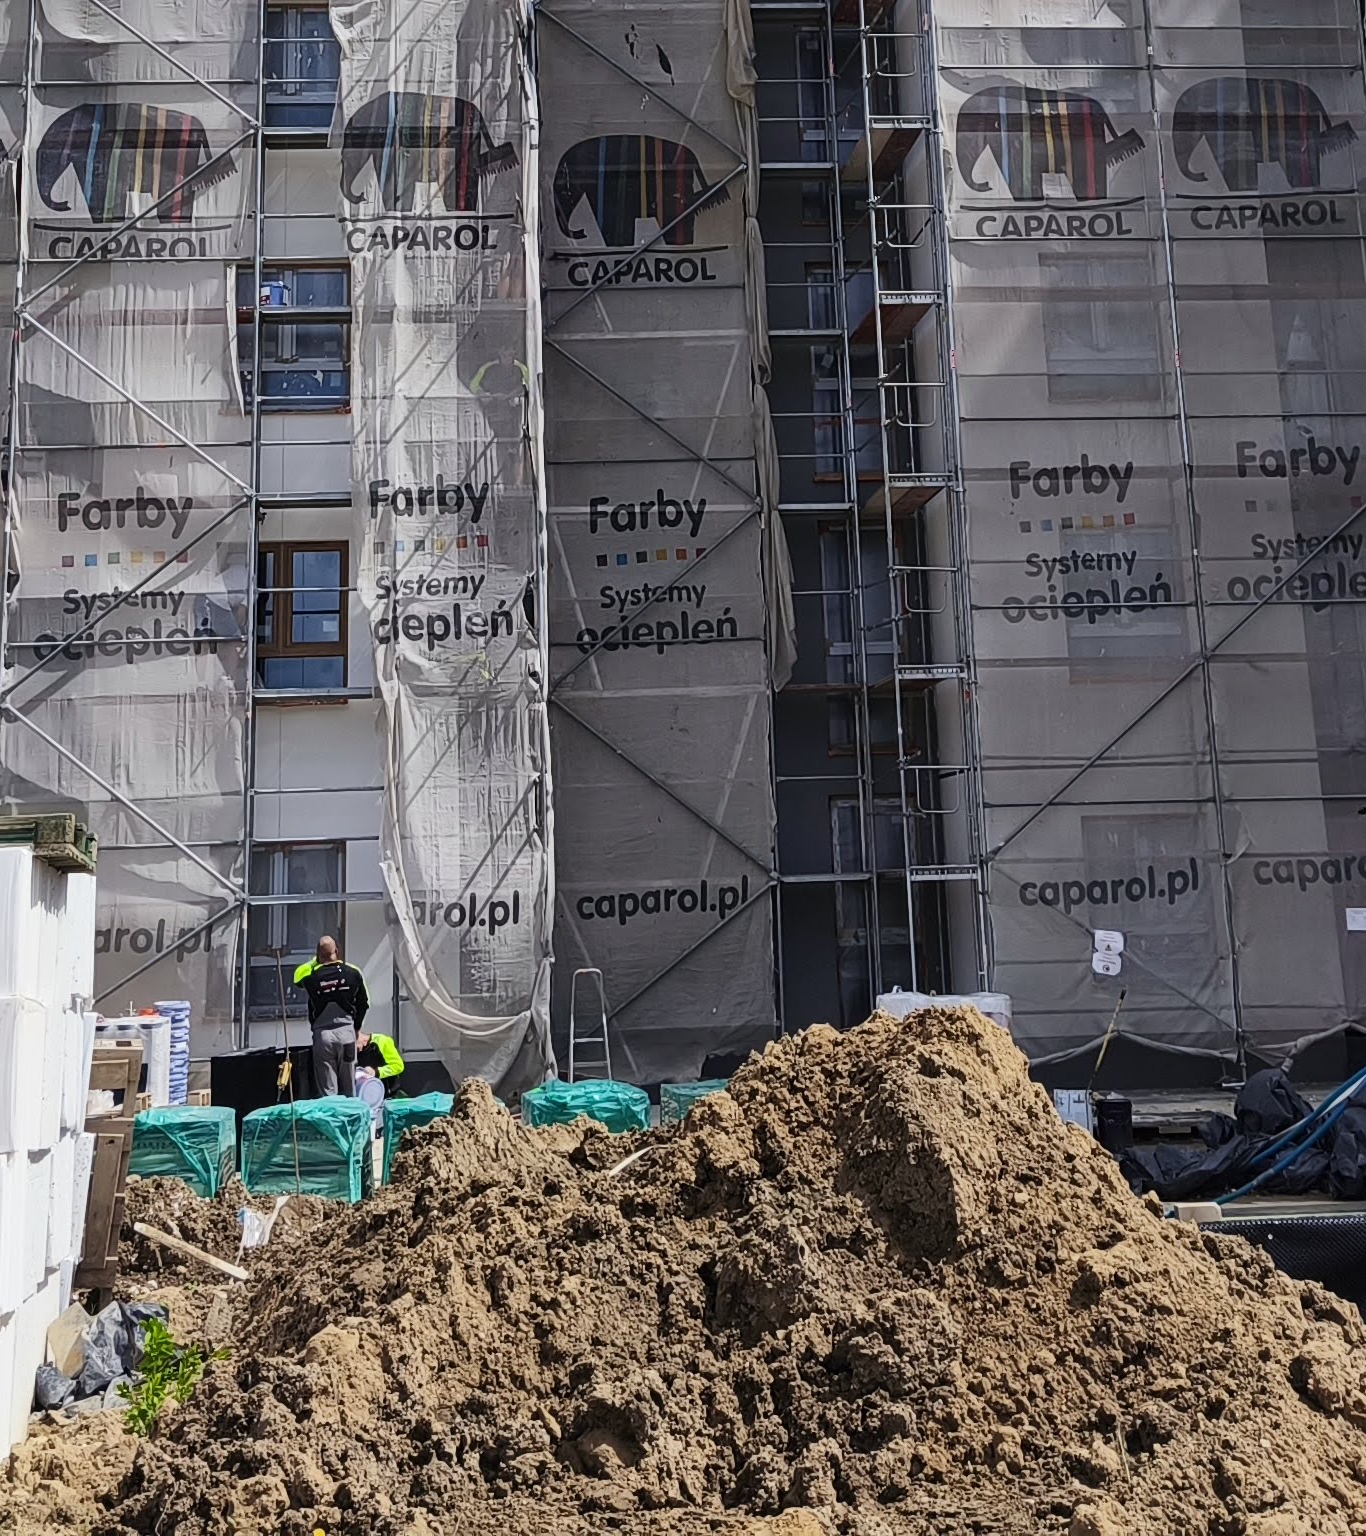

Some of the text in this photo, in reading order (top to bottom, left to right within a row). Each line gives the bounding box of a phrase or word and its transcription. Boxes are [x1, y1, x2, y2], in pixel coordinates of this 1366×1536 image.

[345, 223, 497, 254] CAPAROL
[976, 211, 1132, 238] CAPAROL
[1190, 200, 1347, 232] CAPAROL
[48, 236, 209, 264] CAPAROL
[567, 255, 717, 287] CAPAROL
[1010, 454, 1134, 504] Farby
[1235, 436, 1361, 485] Farby
[57, 486, 193, 539] Farby
[368, 475, 490, 525] Farby
[588, 490, 707, 539] Farby
[1025, 548, 1137, 580] Systemy
[1252, 532, 1364, 562] Systemy
[62, 585, 185, 617] Systemy
[375, 572, 485, 602] Systemy
[600, 583, 707, 612] Systemy
[1001, 572, 1173, 625] ociepleń
[33, 617, 219, 666] ociepleń
[373, 600, 514, 652] ciepleń
[575, 607, 738, 657] ociepleń
[576, 875, 750, 927] caparol.pl
[1018, 858, 1199, 913] caparol.pl
[386, 888, 520, 936] arol.pl
[96, 917, 213, 962] arol.pl
